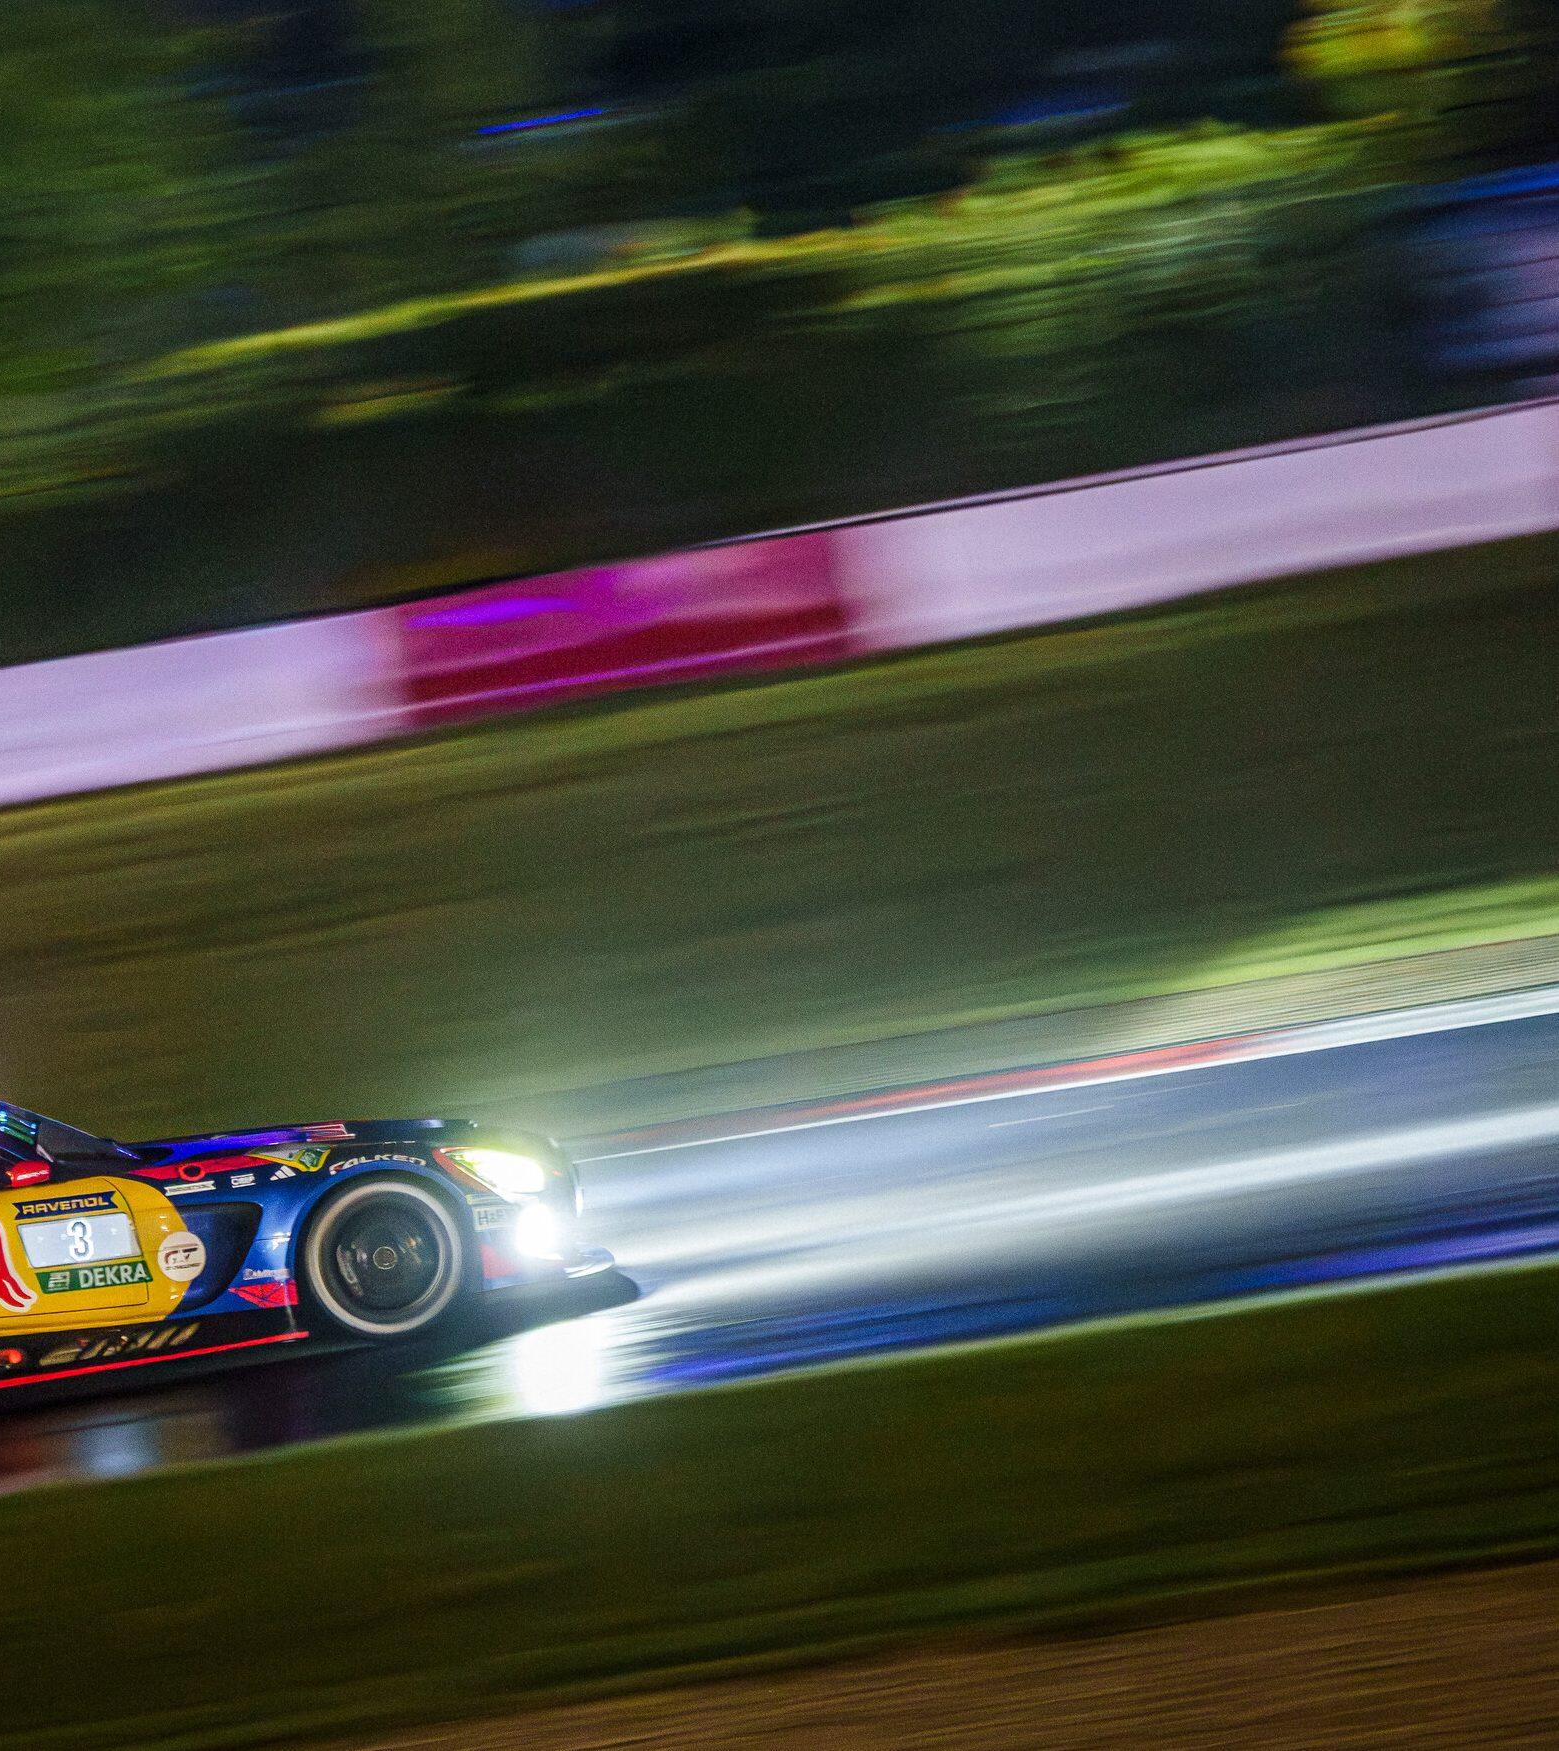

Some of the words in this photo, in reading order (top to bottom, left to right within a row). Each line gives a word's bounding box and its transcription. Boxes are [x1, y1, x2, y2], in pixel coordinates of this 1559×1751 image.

[22, 1196, 109, 1215] RAVENOL
[68, 1219, 92, 1260] 3
[79, 1262, 148, 1288] DEKRA
